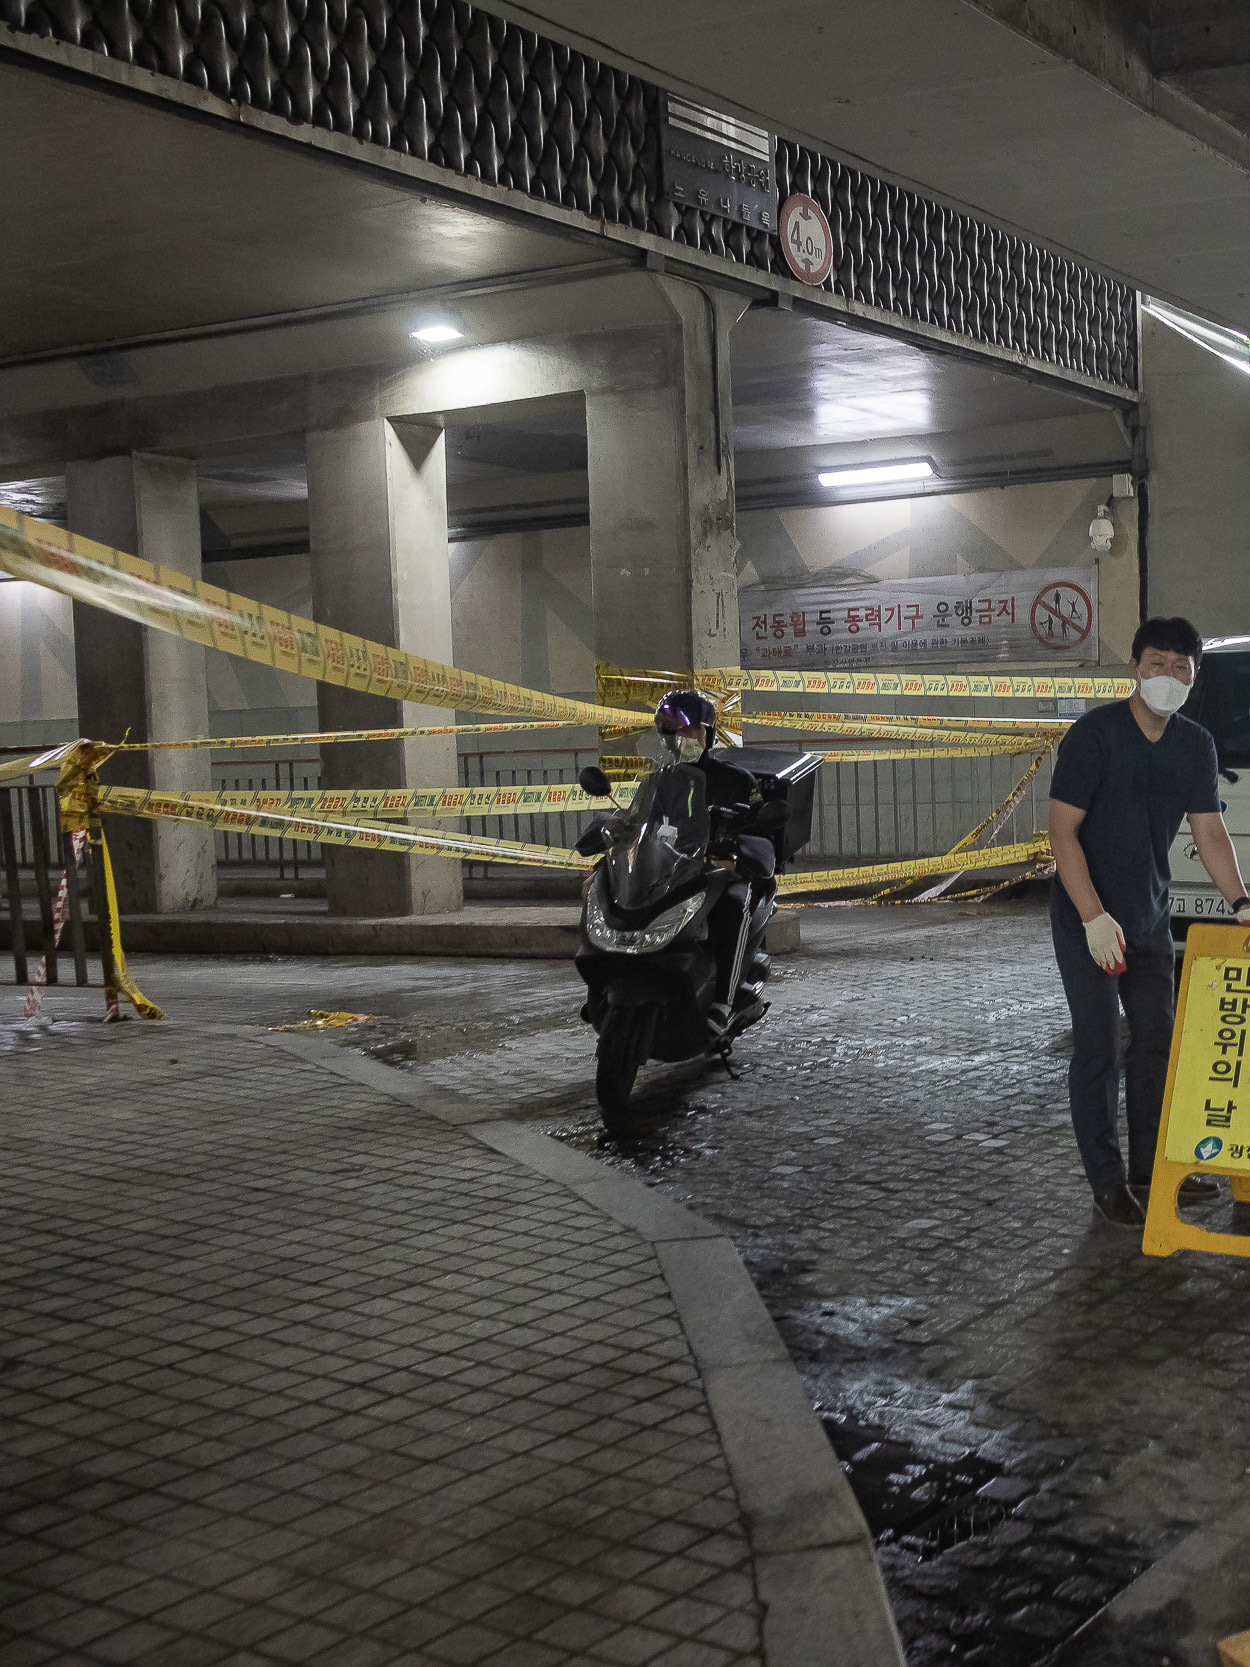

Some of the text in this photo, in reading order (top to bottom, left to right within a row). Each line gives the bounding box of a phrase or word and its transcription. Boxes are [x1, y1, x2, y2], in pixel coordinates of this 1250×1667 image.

[722, 153, 771, 193] 한강공원
[790, 220, 823, 258] 4.0m
[751, 596, 1016, 641] 전동휠 등 동력기구 운행금지
[805, 643, 829, 656] 부과
[1203, 1098, 1238, 1130] 날
